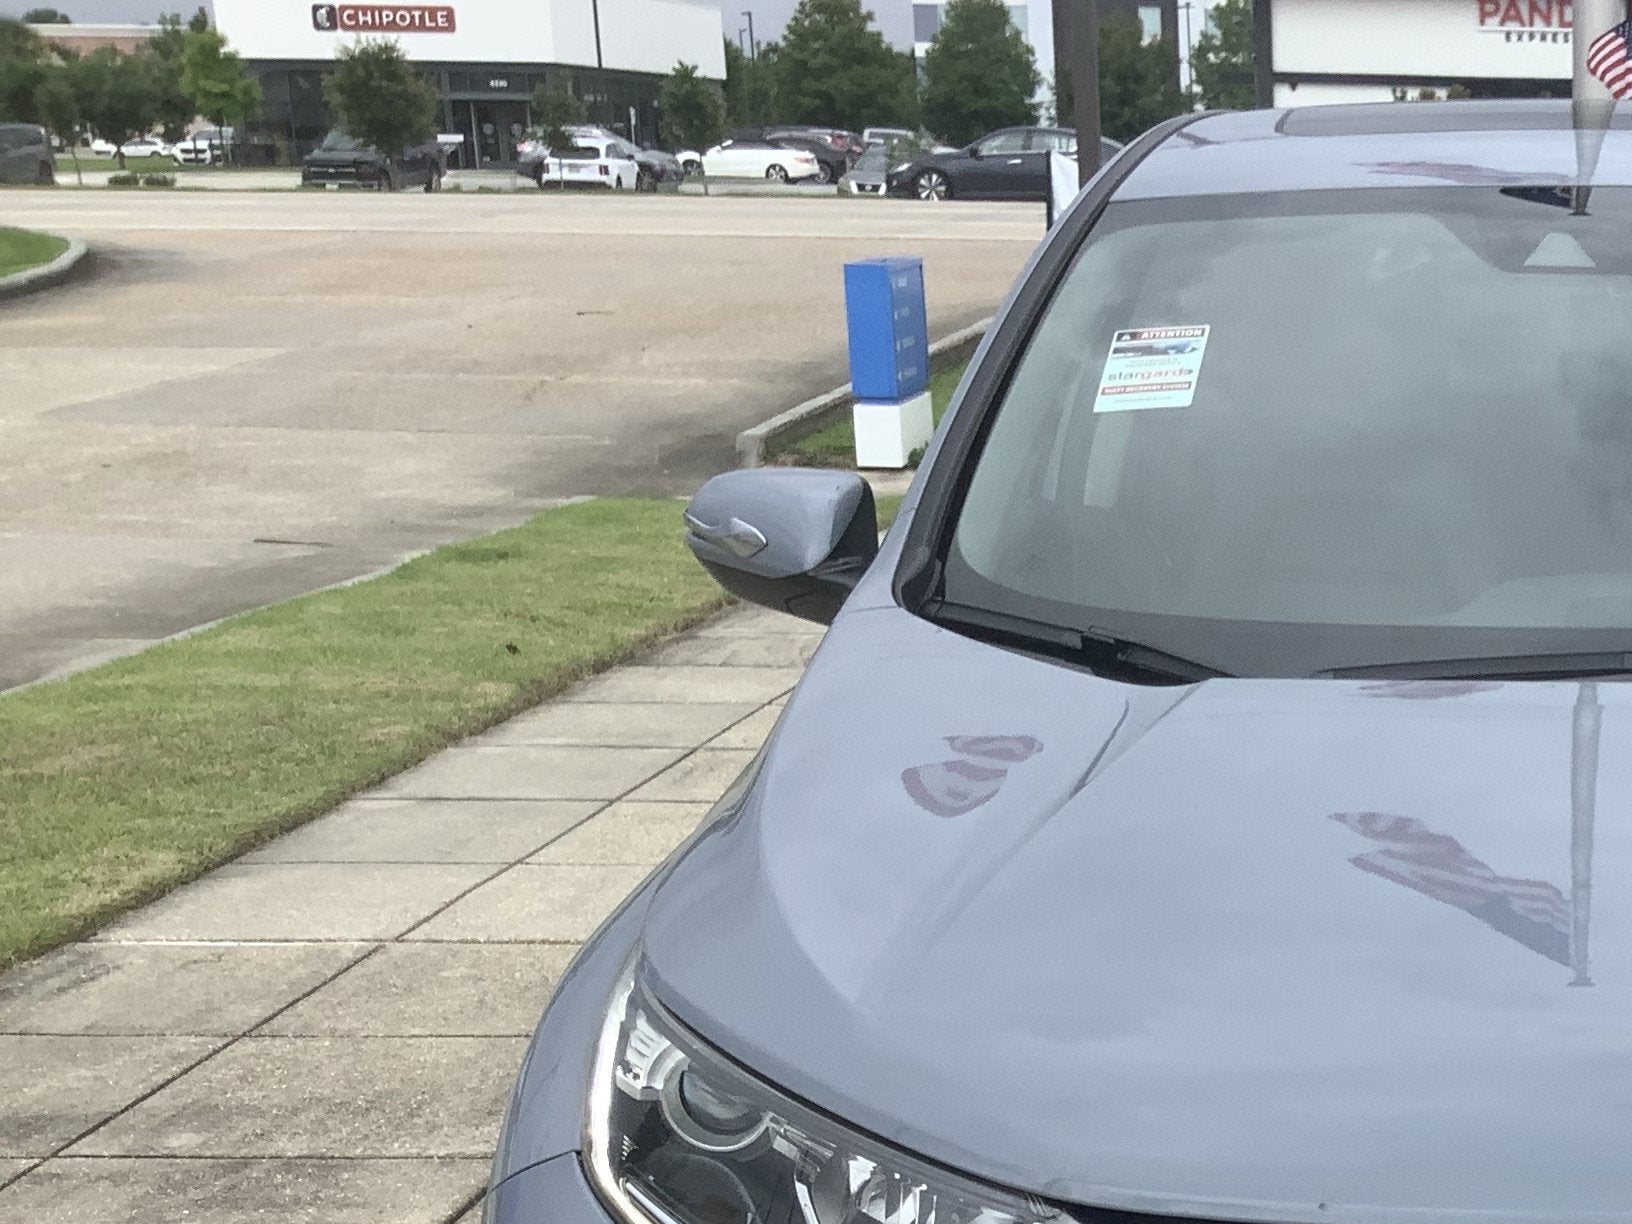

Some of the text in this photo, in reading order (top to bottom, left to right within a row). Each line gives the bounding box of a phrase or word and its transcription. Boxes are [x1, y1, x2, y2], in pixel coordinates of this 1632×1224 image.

[342, 9, 449, 27] CHIPOTLE
[1478, 0, 1573, 28] PAND
[1505, 31, 1571, 43] EXPRES
[1141, 328, 1202, 339] ATTENTION
